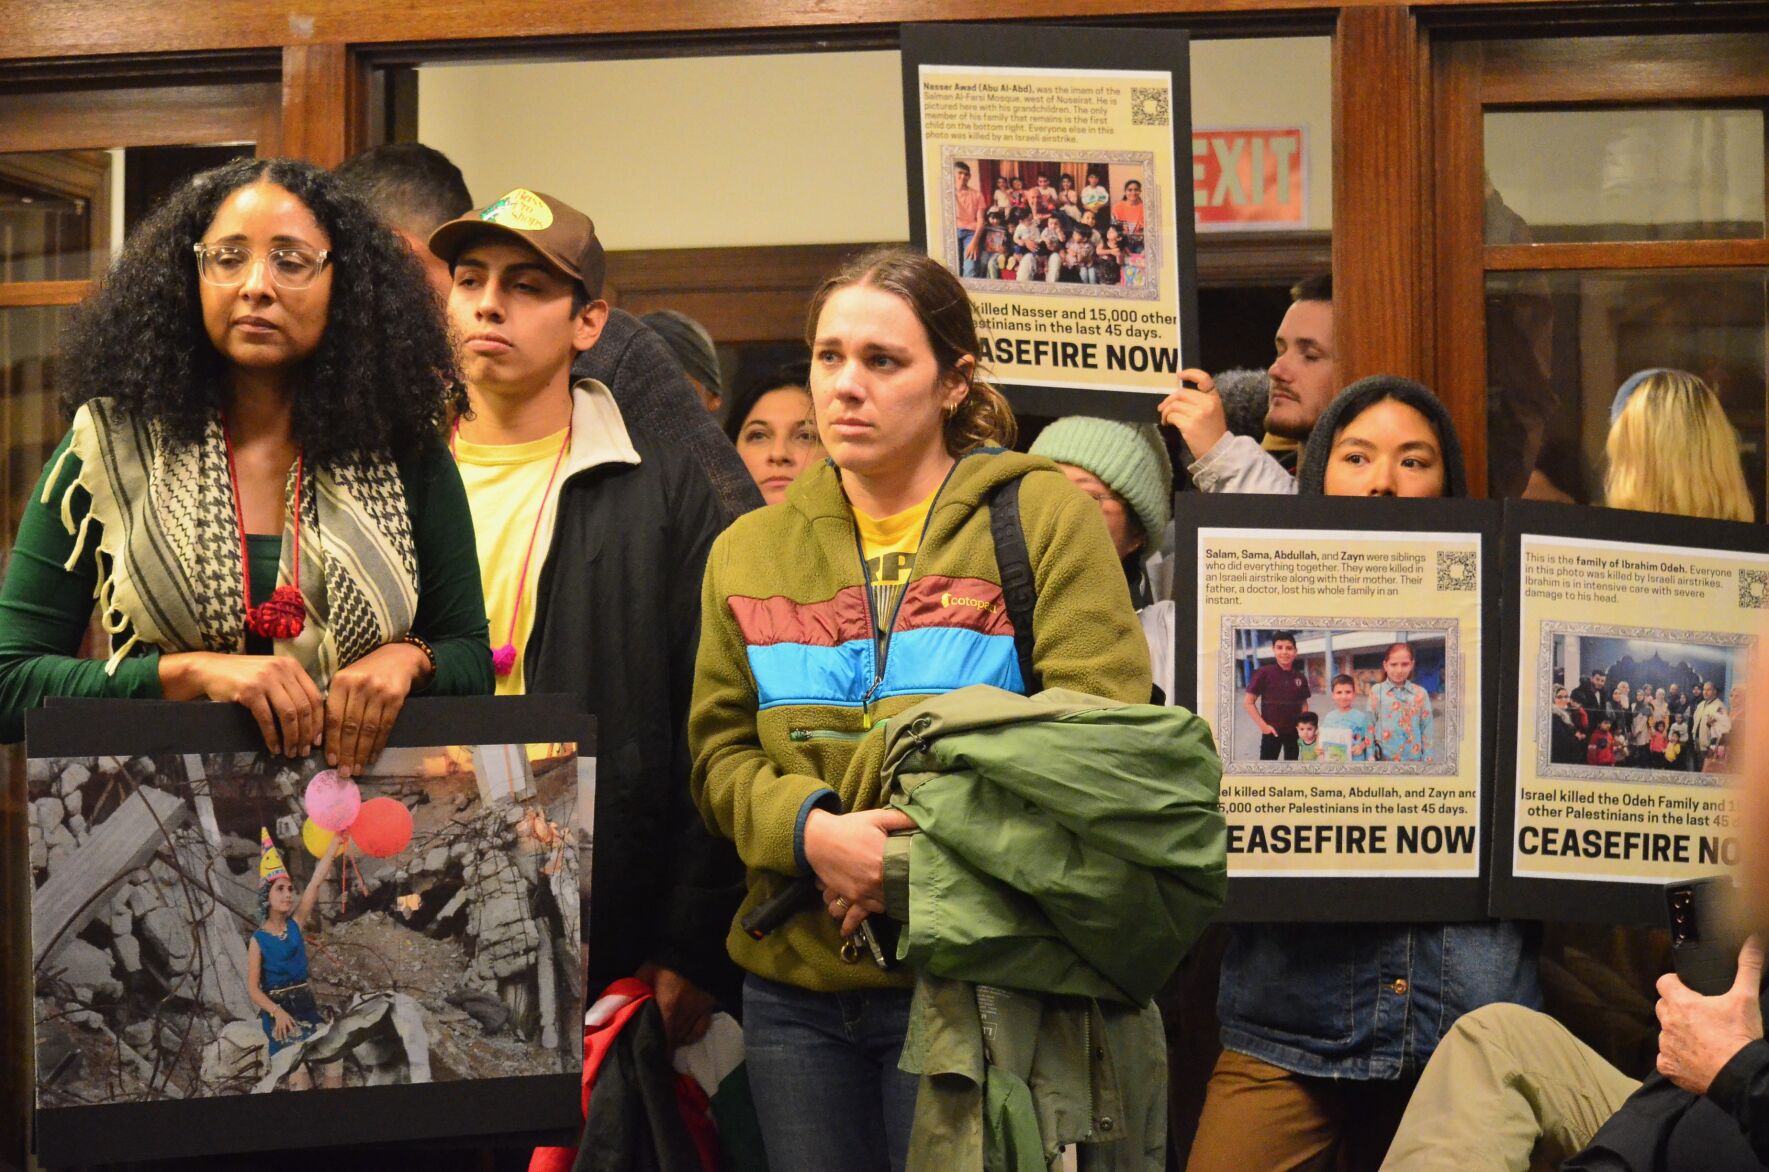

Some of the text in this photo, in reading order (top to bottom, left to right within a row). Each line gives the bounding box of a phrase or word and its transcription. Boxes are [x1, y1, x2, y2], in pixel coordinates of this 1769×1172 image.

[923, 82, 953, 90] Nasser
[954, 83, 977, 91] Awad
[979, 84, 998, 93] (Abu
[1055, 86, 1069, 94] the
[1071, 86, 1093, 94] imam
[1095, 87, 1104, 95] of
[1106, 87, 1121, 95] the
[924, 92, 953, 100] Salman
[955, 93, 985, 101] Al-Farsi
[1024, 95, 1044, 103] west
[1046, 95, 1055, 103] of
[1096, 97, 1108, 105] He
[1110, 97, 1117, 105] is
[924, 102, 958, 112] pictured
[959, 103, 978, 111] here
[999, 104, 1011, 112] his
[1013, 105, 1071, 115] grandchildren.
[1074, 106, 1088, 114] The
[1090, 107, 1108, 116] only
[924, 112, 957, 120] member
[969, 113, 981, 121] his
[983, 113, 1008, 123] family
[1010, 114, 1027, 122] that
[1030, 115, 1062, 123] remains
[1073, 116, 1088, 124] the
[1090, 116, 1108, 124] first
[925, 121, 944, 129] child
[958, 122, 971, 130] the
[973, 123, 1004, 131] bottom
[1028, 124, 1067, 135] Everyone
[1088, 126, 1096, 134] in
[1098, 126, 1115, 134] this
[925, 131, 949, 141] photo
[992, 133, 1002, 142] by
[1015, 134, 1040, 142] Israeli
[1042, 135, 1078, 143] airstrike.
[1012, 304, 1058, 319] Nasser
[1062, 307, 1086, 320] and
[1089, 308, 1138, 324] 15,000
[1140, 311, 1177, 325] other
[974, 317, 1162, 341] estinians in the last 45 days.
[979, 336, 1178, 374] ASEFIRE NOW
[1206, 549, 1239, 560] Salam,
[1241, 550, 1272, 561] Sama,
[1274, 550, 1320, 561] Abdullah,
[1321, 551, 1339, 561] and
[1340, 551, 1364, 563] Zayn
[1390, 552, 1426, 564] siblings
[1206, 561, 1424, 574] who did everything together. They were killed in
[1525, 552, 1732, 579] This is the family of Ibrahim Odeh. Everyone
[1219, 572, 1247, 582] Israeli
[1249, 573, 1288, 583] airstrike
[1289, 574, 1315, 585] along
[1316, 574, 1337, 583] with
[1339, 574, 1361, 584] their
[1362, 575, 1399, 584] mother.
[1400, 575, 1423, 585] Their
[1525, 564, 1722, 588] in this photo was killed by Israeli airstrikes.
[1206, 584, 1237, 594] father,
[1246, 584, 1280, 595] doctor,
[1281, 585, 1299, 594] lost
[1301, 585, 1316, 594] his
[1317, 585, 1345, 595] whole
[1346, 586, 1374, 597] family
[1376, 586, 1385, 595] in
[1387, 588, 1399, 596] an
[1525, 575, 1705, 598] Ibrahim is in intensive care with severe
[1205, 595, 1242, 605] instant.
[1524, 587, 1563, 601] damage
[1565, 591, 1575, 600] to
[1577, 591, 1591, 601] his
[1234, 787, 1266, 797] killed
[1269, 787, 1308, 799] Salam,
[1310, 787, 1346, 799] Sama,
[1349, 787, 1402, 799] Abdullah,
[1404, 787, 1425, 798] and
[1428, 787, 1455, 801] Zayn
[1520, 788, 1557, 802] Israel
[1559, 790, 1594, 804] killed
[1598, 792, 1619, 805] the
[1622, 794, 1655, 808] Odeh
[1658, 796, 1699, 813] Family
[1702, 798, 1725, 812] and
[1217, 802, 1468, 817] 5,000 other Palestinians in the last 45 days.
[1527, 804, 1562, 818] other
[1566, 806, 1644, 822] Palestinians
[1648, 811, 1659, 823] in
[1662, 812, 1683, 825] the
[1686, 813, 1709, 826] last
[1713, 815, 1729, 827] 45
[1226, 825, 1476, 854] EASEFIRE NOW
[1518, 826, 1742, 867] CEASEFIRE NO
